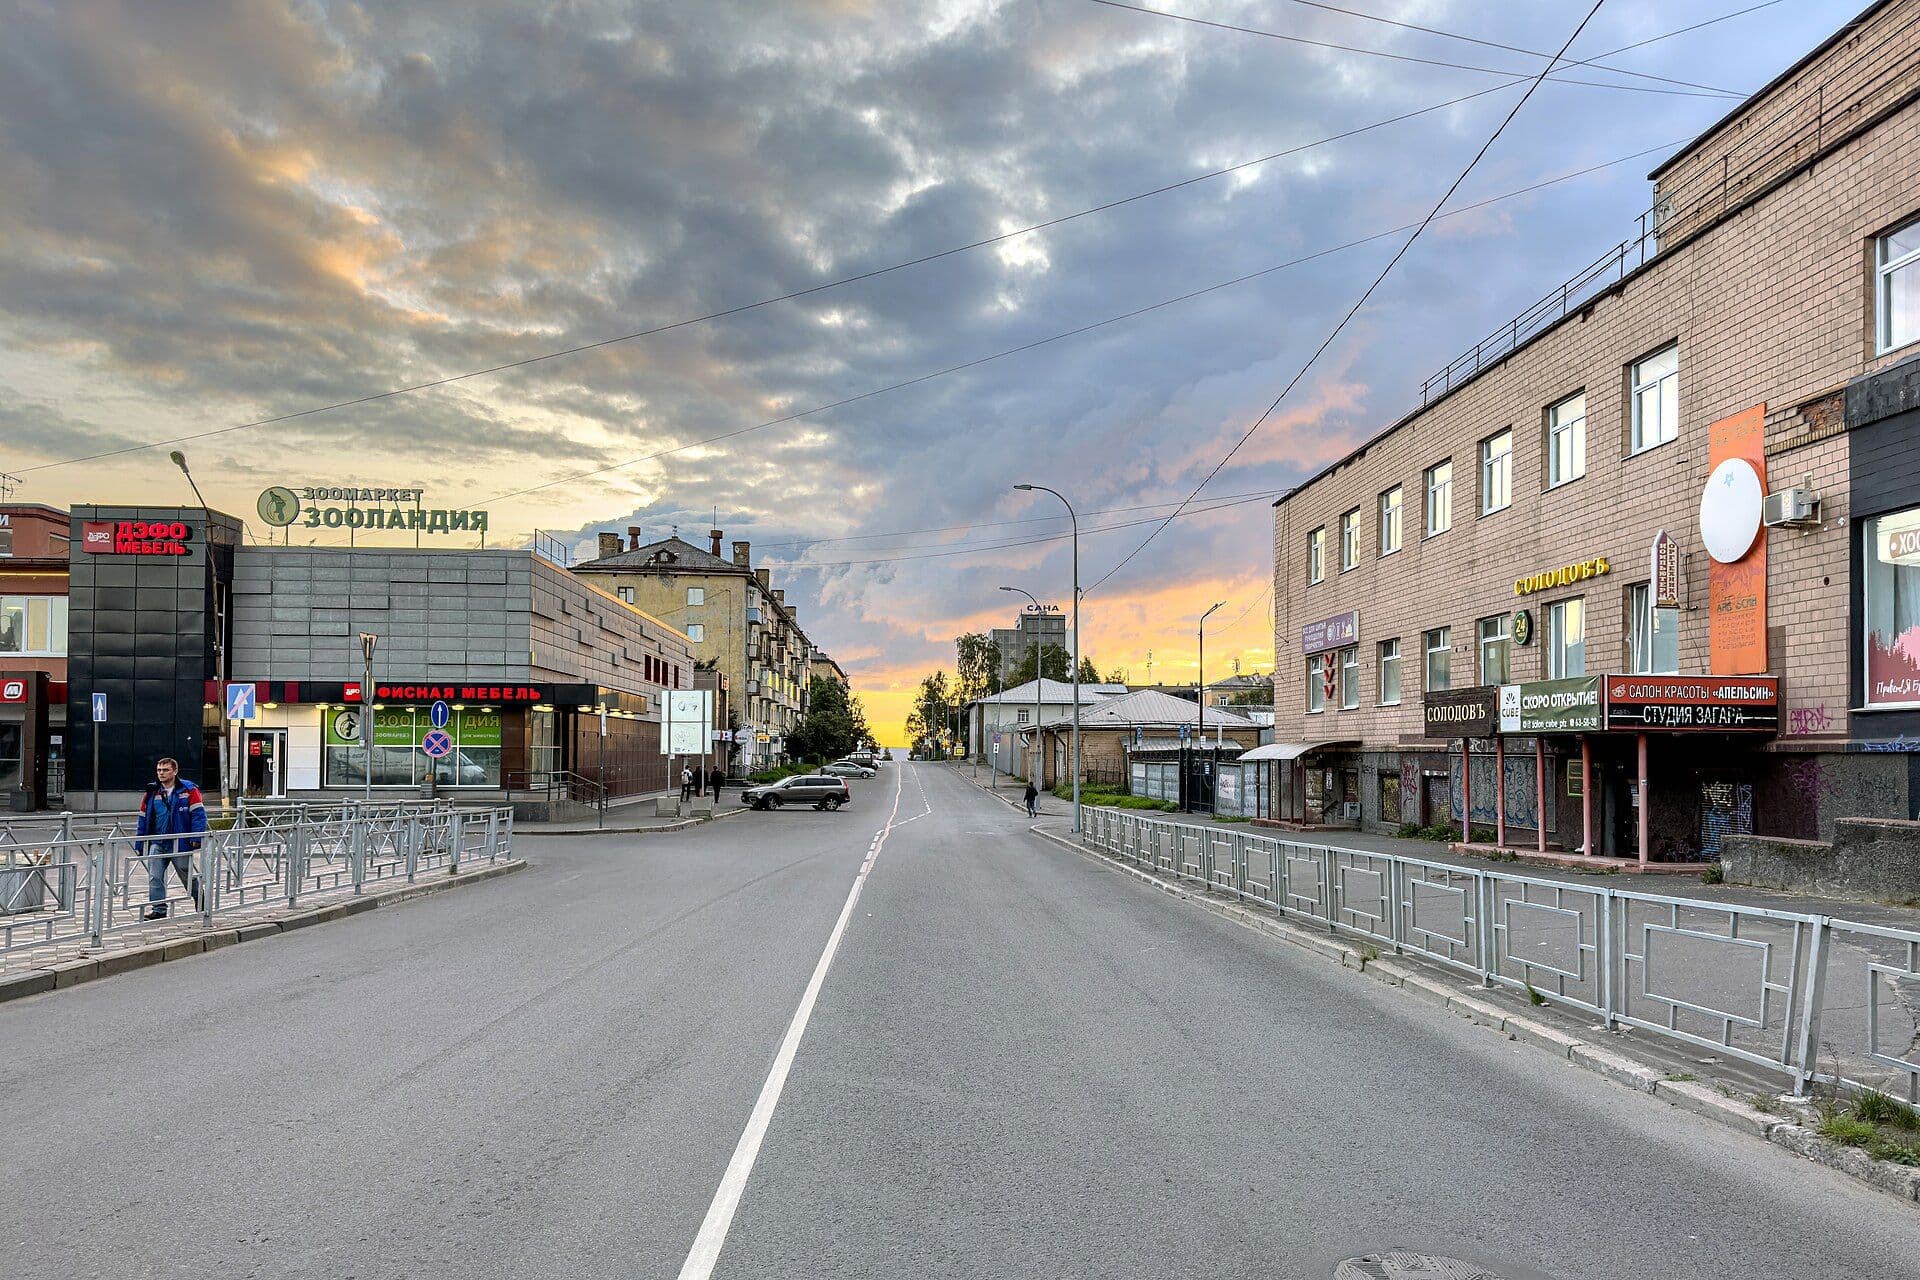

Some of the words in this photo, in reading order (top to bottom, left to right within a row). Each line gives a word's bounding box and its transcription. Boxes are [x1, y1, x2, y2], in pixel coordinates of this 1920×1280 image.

[303, 487, 424, 501] ЗООМАРКЕТ
[303, 507, 488, 534] ЗООЛАНДИЯ
[116, 522, 188, 540] ДЭФО
[116, 541, 188, 556] МЕБЕЛЬ
[1514, 556, 1611, 596] СОЛОДОВЪ
[1515, 618, 1526, 633] 24
[377, 687, 455, 699] ФИСНАЯ
[461, 687, 541, 700] МЕБЕЛЬ
[1522, 694, 1550, 709] СКОРО
[1550, 690, 1598, 707] ОТКРЫТИЕ!
[1629, 684, 1662, 699] САЛОН
[1664, 684, 1710, 699] КРАСОТЫ
[1712, 686, 1774, 700] «АПЕЛЬСИН»
[1427, 703, 1486, 722] СОЛОДОВЪ
[1502, 707, 1519, 718] CUBE
[1643, 705, 1693, 727] СТУДИЯ
[1696, 706, 1744, 725] ЗАГАРА
